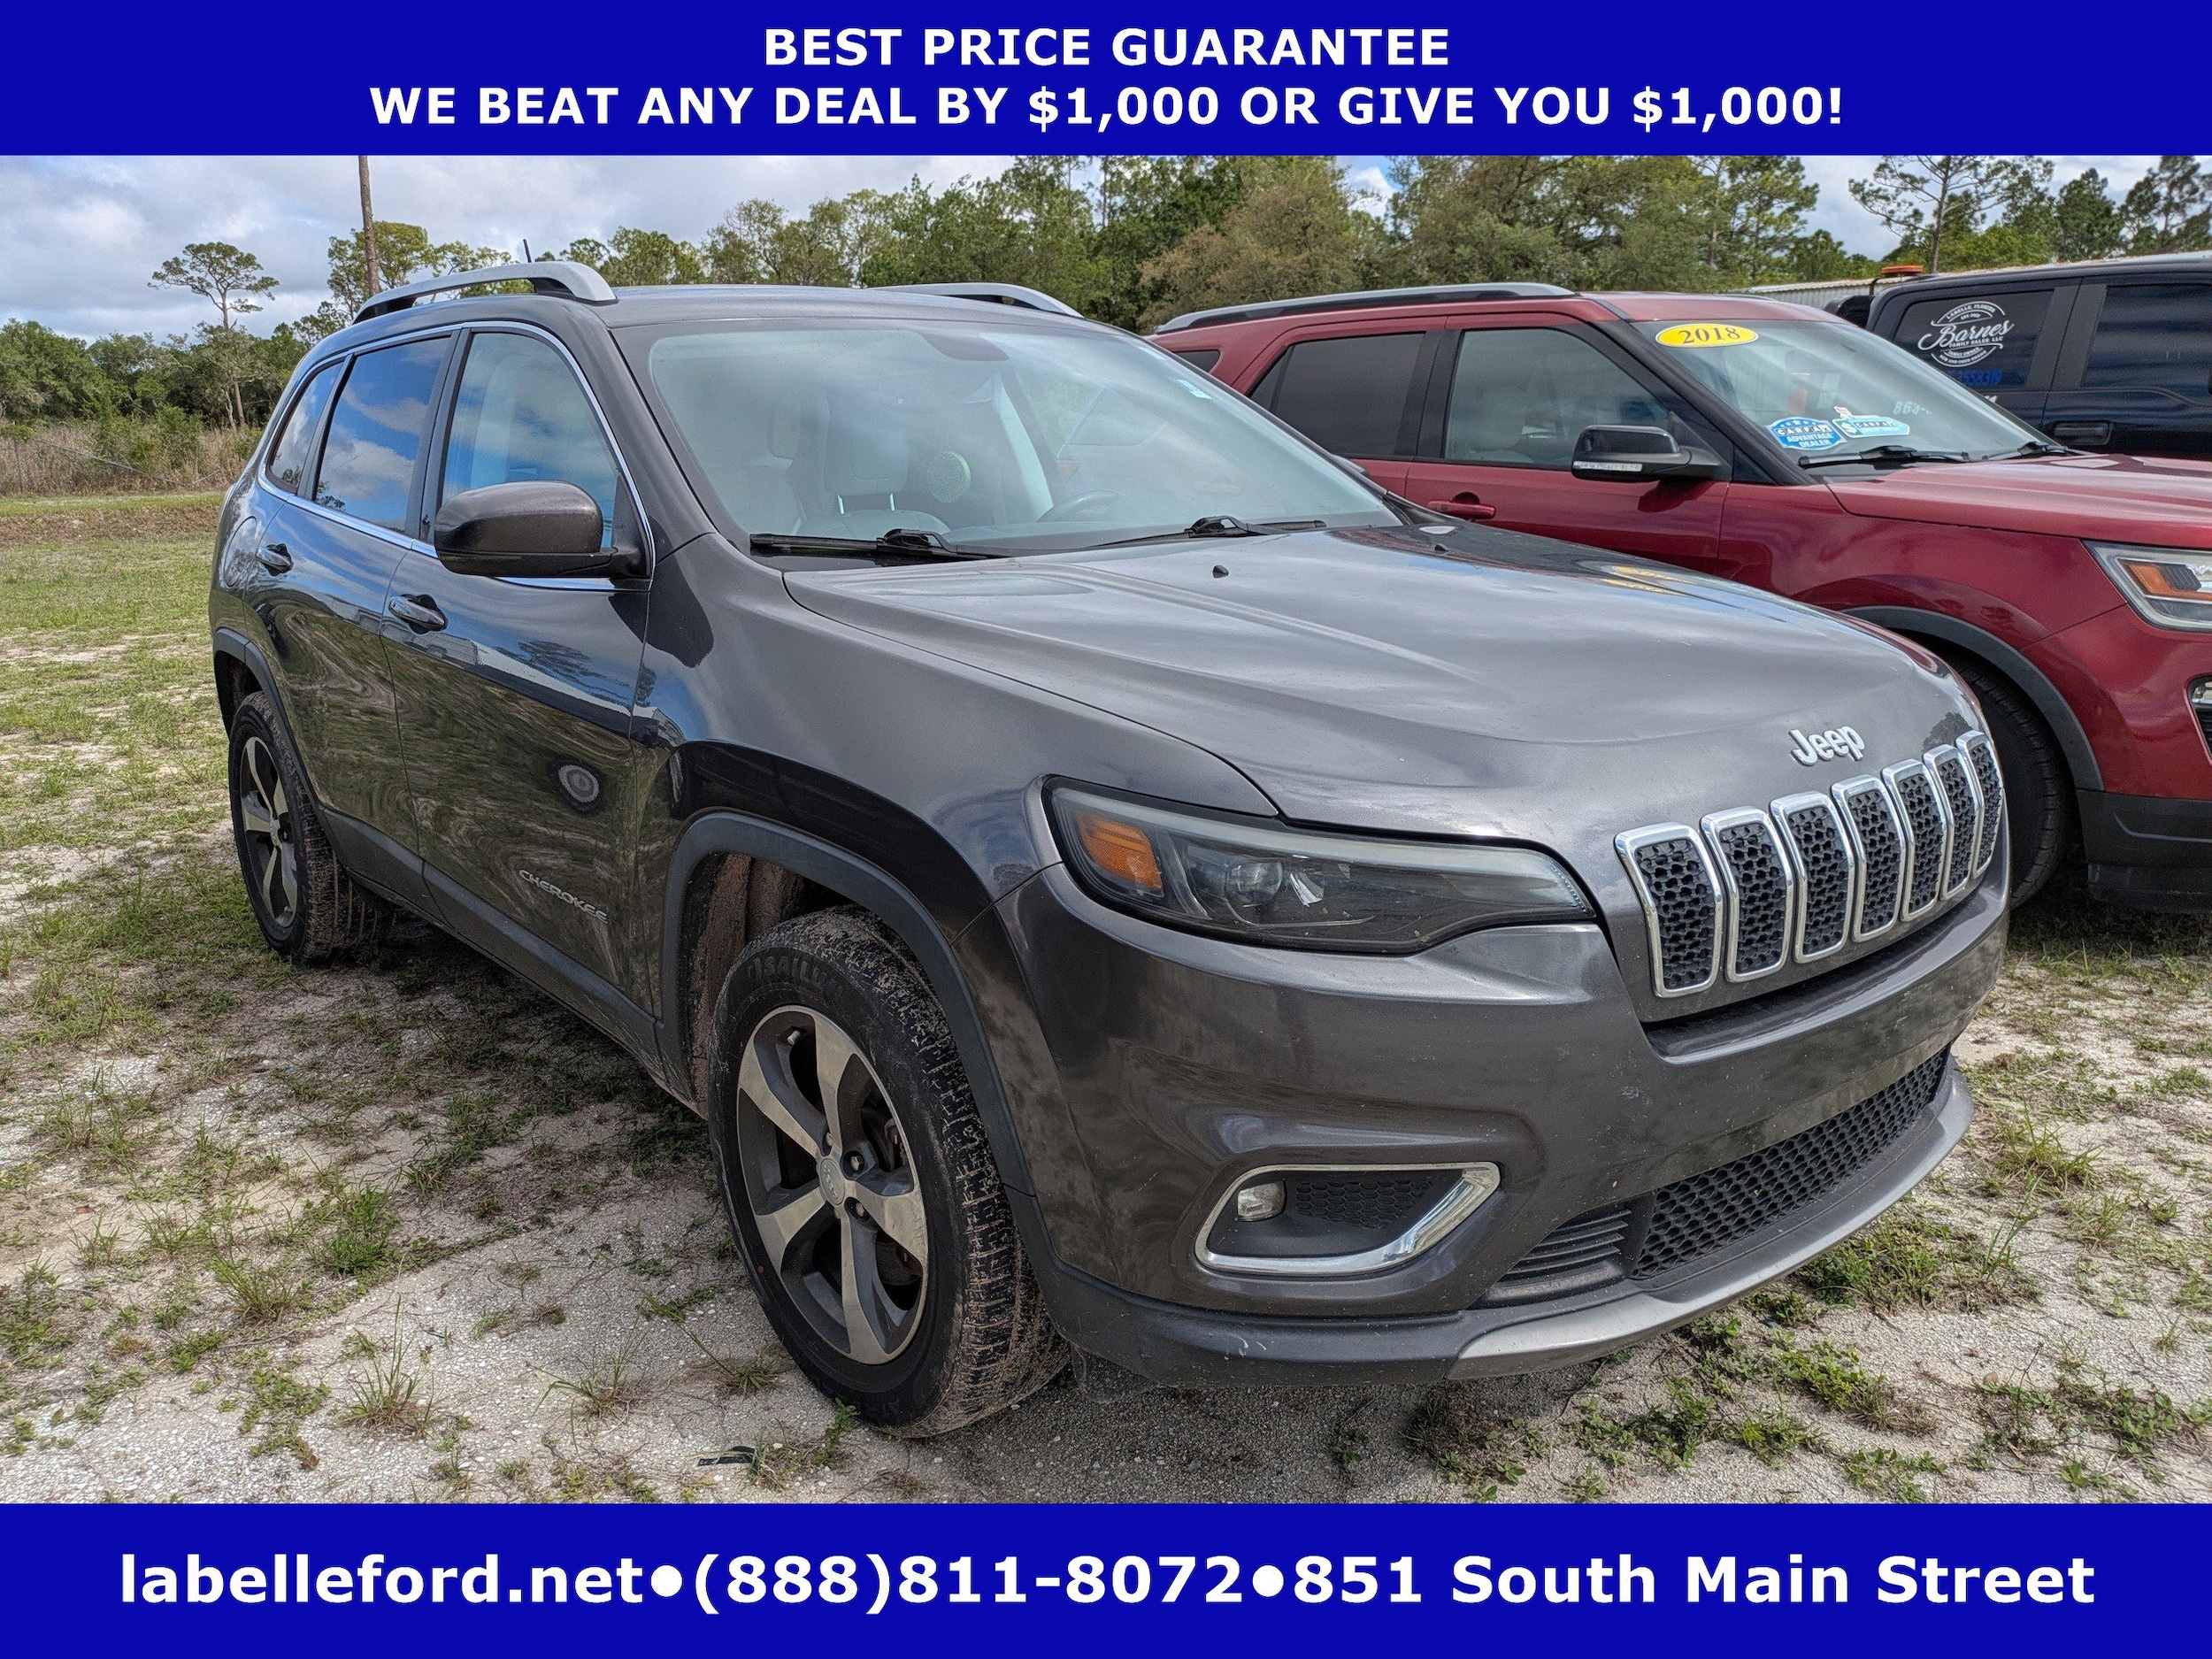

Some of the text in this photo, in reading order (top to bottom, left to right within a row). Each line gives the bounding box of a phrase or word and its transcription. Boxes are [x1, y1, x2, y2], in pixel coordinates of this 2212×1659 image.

[1678, 327, 1740, 344] 2018
[1917, 319, 2015, 350] Barnes
[1777, 425, 1832, 435] CARFAX
[1786, 433, 1834, 442] ADVANTAGE
[1798, 439, 1832, 448] DEALER
[1788, 726, 1864, 766] Jeep
[519, 869, 610, 925] CHEROKEE
